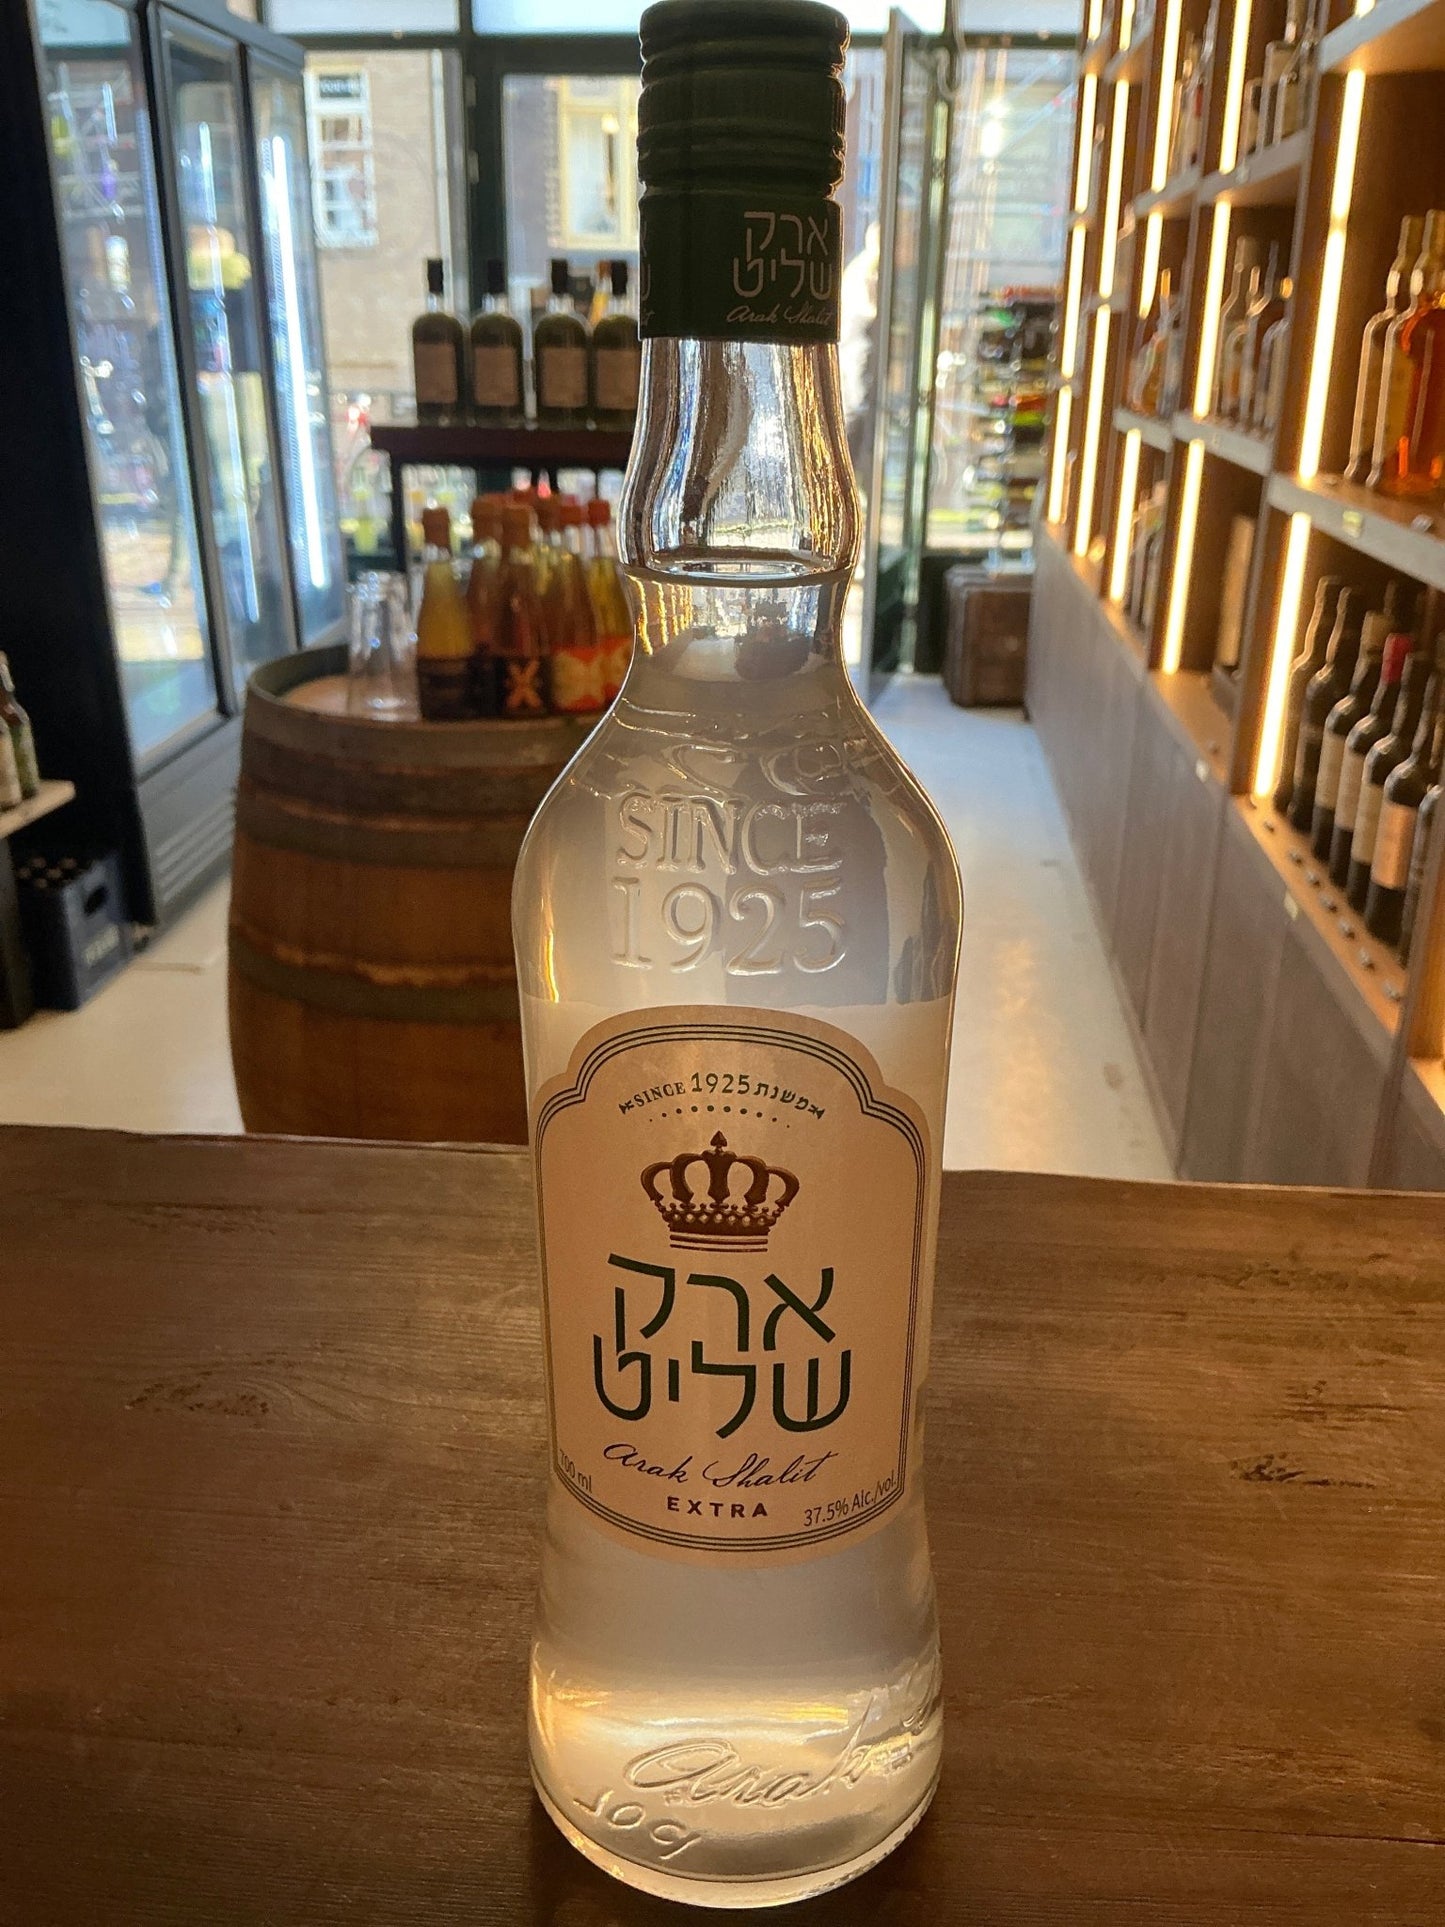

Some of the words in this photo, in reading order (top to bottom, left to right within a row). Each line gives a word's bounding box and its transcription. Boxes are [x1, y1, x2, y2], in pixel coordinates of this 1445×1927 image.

[744, 210, 829, 262] ארק
[732, 248, 833, 300] שליט
[615, 791, 844, 875] SINCE
[610, 876, 846, 976] 1925
[633, 1081, 686, 1108] SINCE
[691, 1072, 750, 1094] 1925
[753, 1081, 810, 1111] משנת
[607, 1252, 837, 1356] ארק
[593, 1333, 852, 1440] שליט
[559, 1448, 576, 1479] 700
[577, 1471, 593, 1494] ml
[603, 1443, 694, 1484] Arak
[702, 1450, 839, 1489] Shalit
[666, 1495, 769, 1518] EXTRA
[803, 1497, 849, 1527] 37.5%
